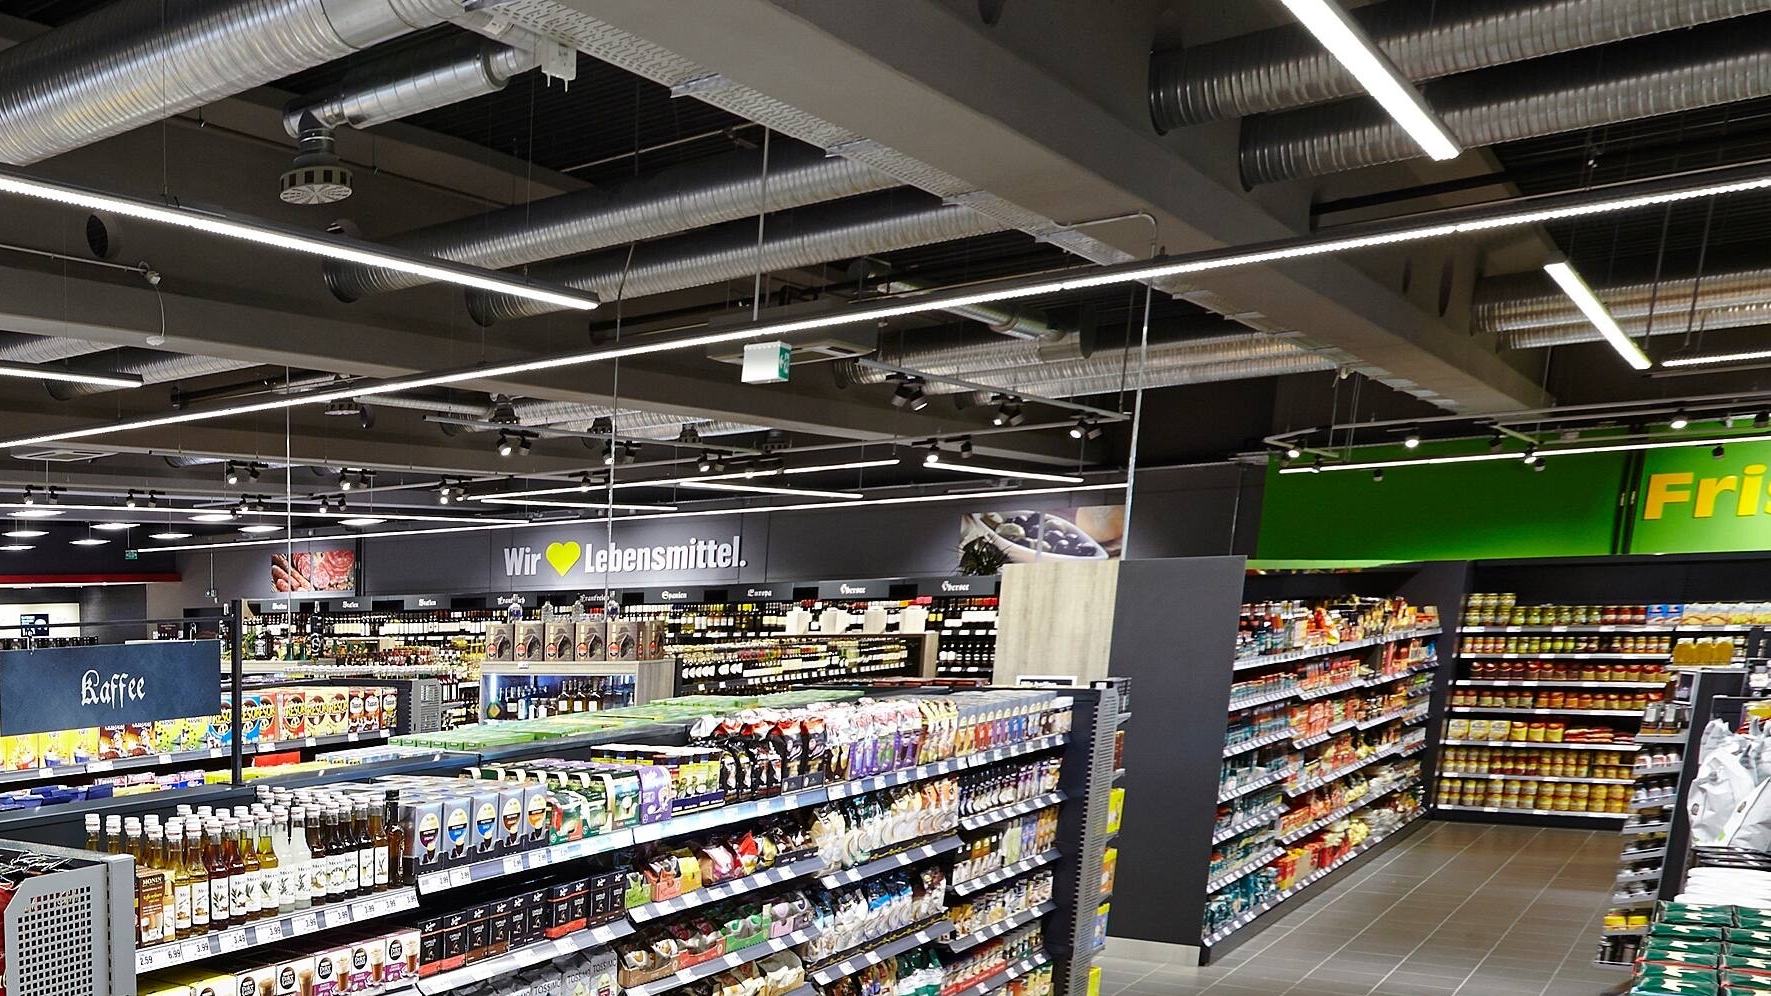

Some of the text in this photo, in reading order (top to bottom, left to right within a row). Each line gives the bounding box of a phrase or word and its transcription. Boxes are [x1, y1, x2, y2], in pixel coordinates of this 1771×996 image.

[1644, 463, 1771, 520] Fri
[503, 536, 747, 576] Wir Lebensmittel.
[80, 670, 146, 709] Kaffee
